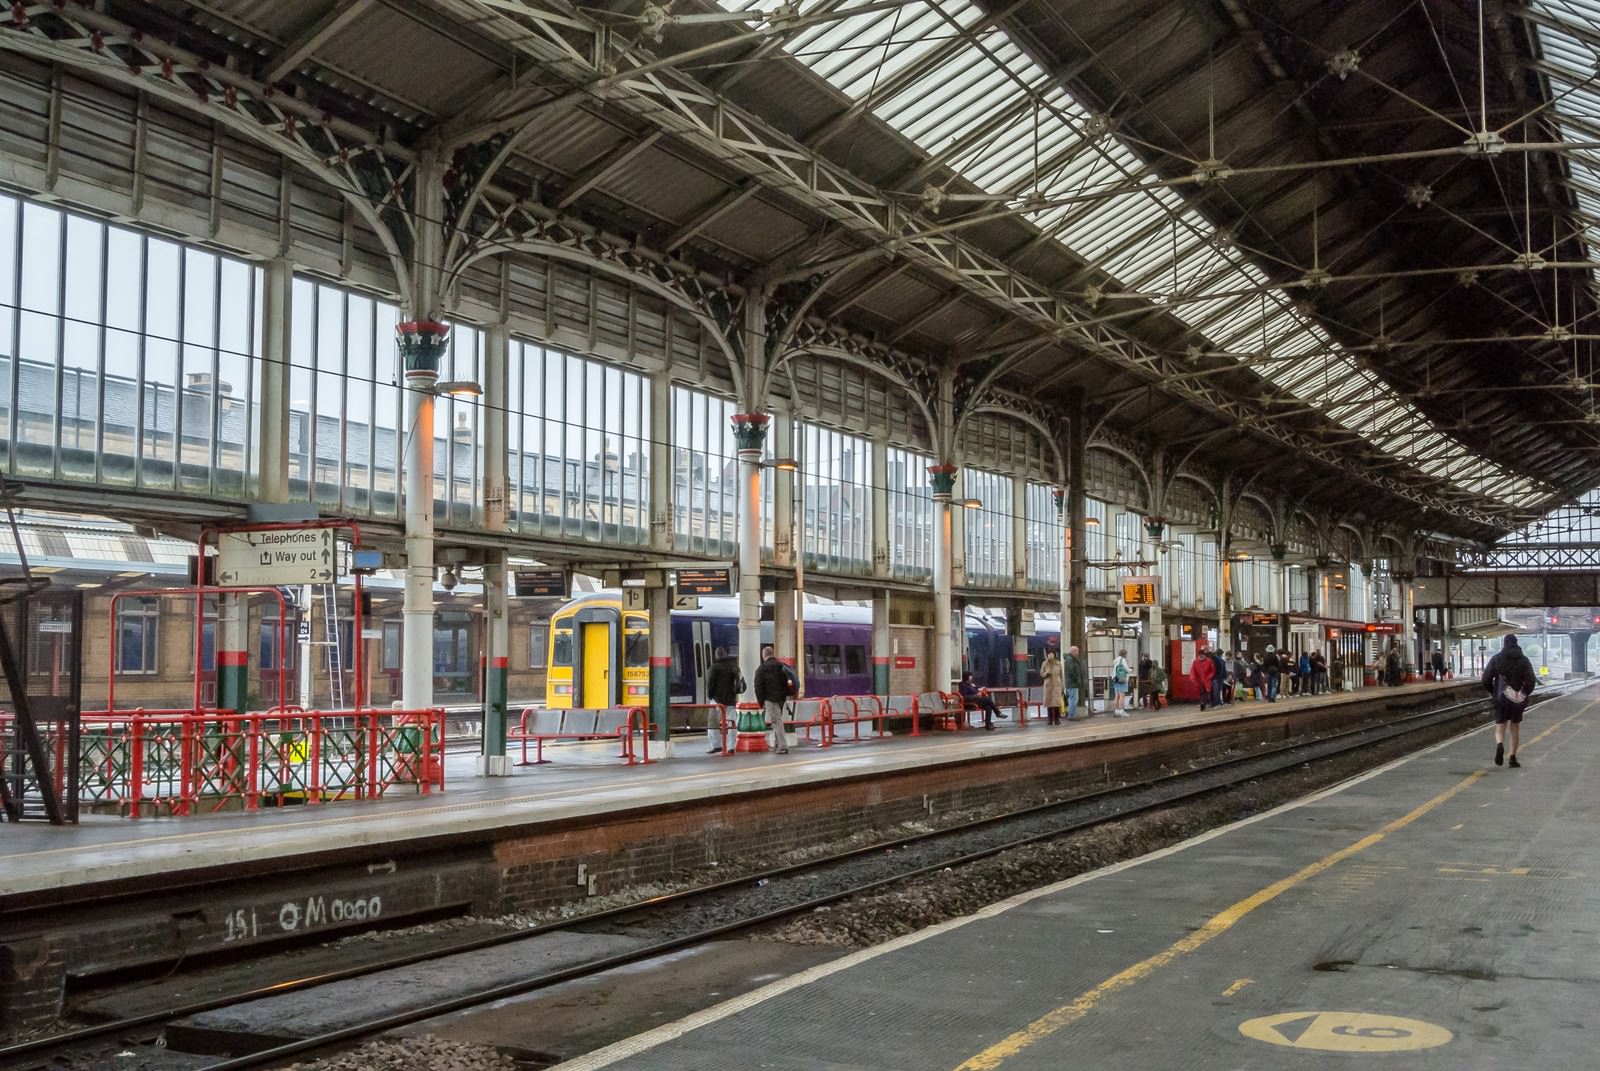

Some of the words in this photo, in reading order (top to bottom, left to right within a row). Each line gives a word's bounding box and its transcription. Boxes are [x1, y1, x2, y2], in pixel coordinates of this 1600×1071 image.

[262, 533, 316, 545] Telephones
[275, 551, 297, 563] Way
[300, 550, 317, 561] out
[234, 571, 239, 581] 1
[310, 568, 317, 579] 2
[626, 589, 640, 607] 1b
[1332, 1025, 1412, 1038] 6
